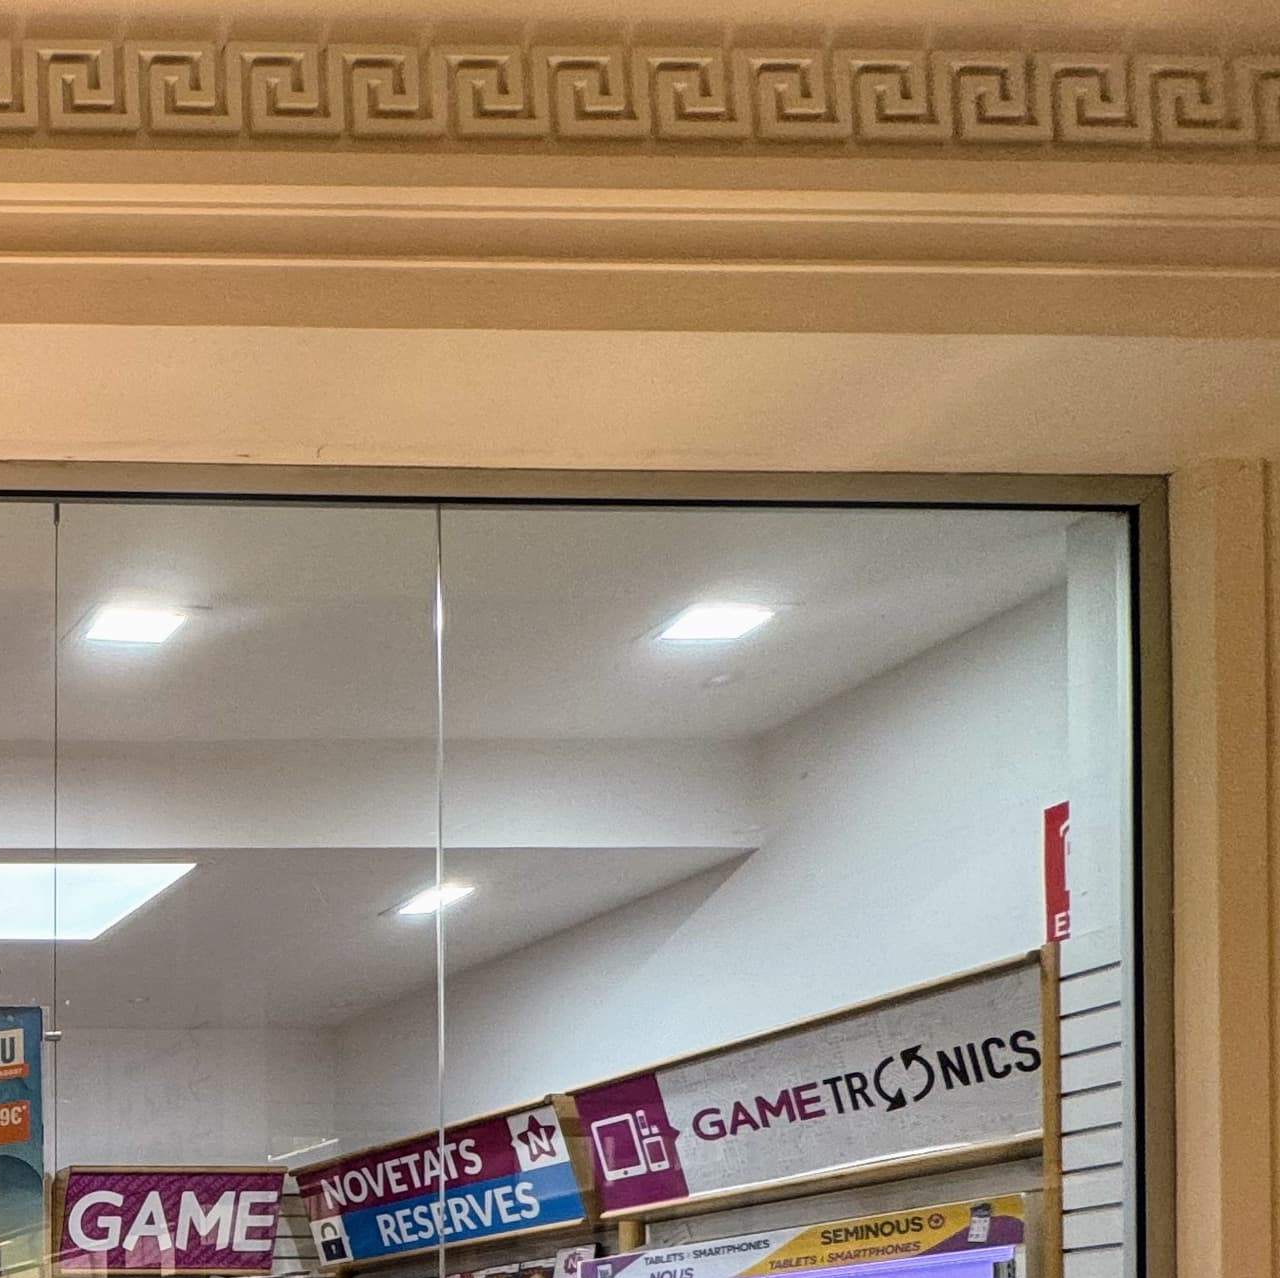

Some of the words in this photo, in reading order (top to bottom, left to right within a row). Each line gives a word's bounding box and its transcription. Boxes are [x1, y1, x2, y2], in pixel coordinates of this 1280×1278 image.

[320, 1138, 483, 1210] NOVETATS
[68, 1190, 279, 1252] GAME
[377, 1182, 540, 1247] RESERVES
[820, 1216, 923, 1245] SEMINOUS
[644, 1252, 687, 1266] TABLETS
[692, 1239, 771, 1260] SMARTPHONES
[768, 1255, 817, 1270] TABLETS
[827, 1241, 921, 1265] SMARTPHONES
